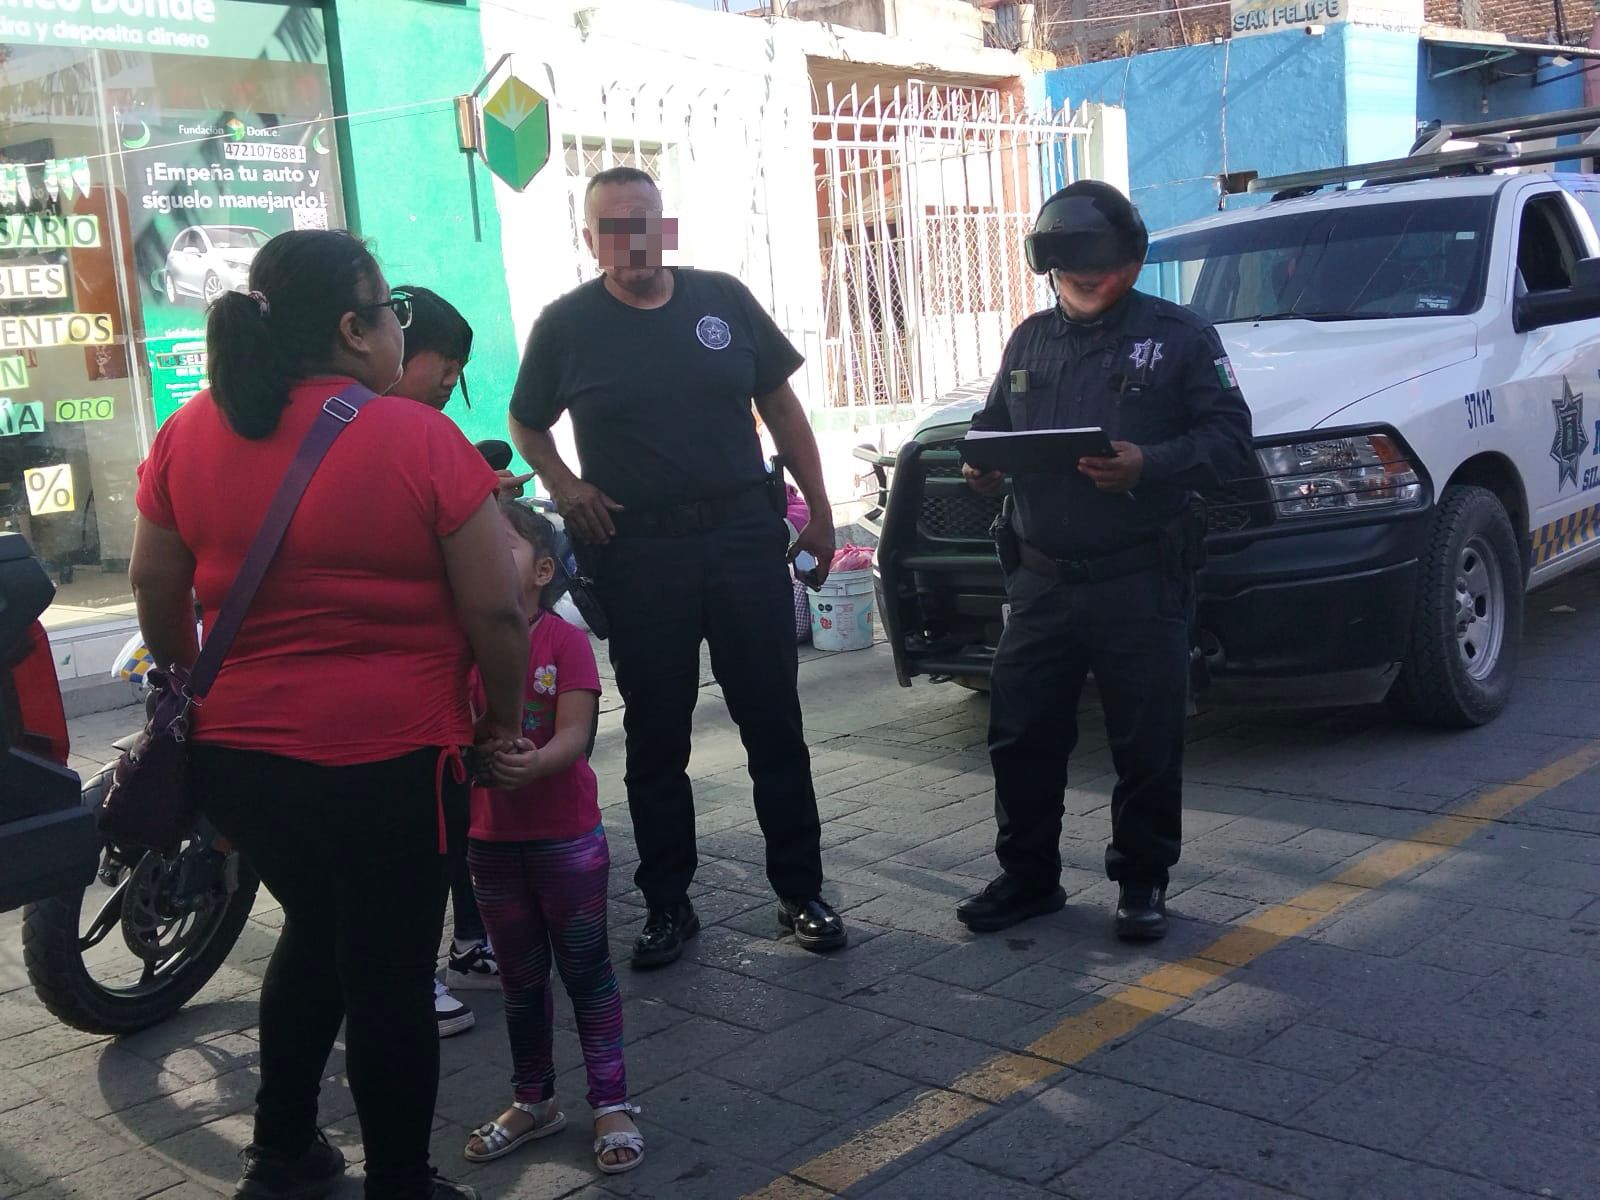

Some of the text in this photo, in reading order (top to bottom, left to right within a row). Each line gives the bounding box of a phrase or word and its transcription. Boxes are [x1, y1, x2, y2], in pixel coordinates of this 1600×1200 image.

[1233, 0, 1340, 32] SAN FELIPE
[33, 21, 48, 42] y
[53, 20, 143, 45] deposita
[147, 27, 209, 48] dinero
[225, 144, 305, 161] 4721076881
[146, 162, 320, 187] ¡Empeña tu auto y
[143, 190, 328, 214] síguelo manejando!
[2, 316, 110, 346] ENTOS
[59, 400, 112, 420] ORO
[1465, 389, 1494, 429] 37112
